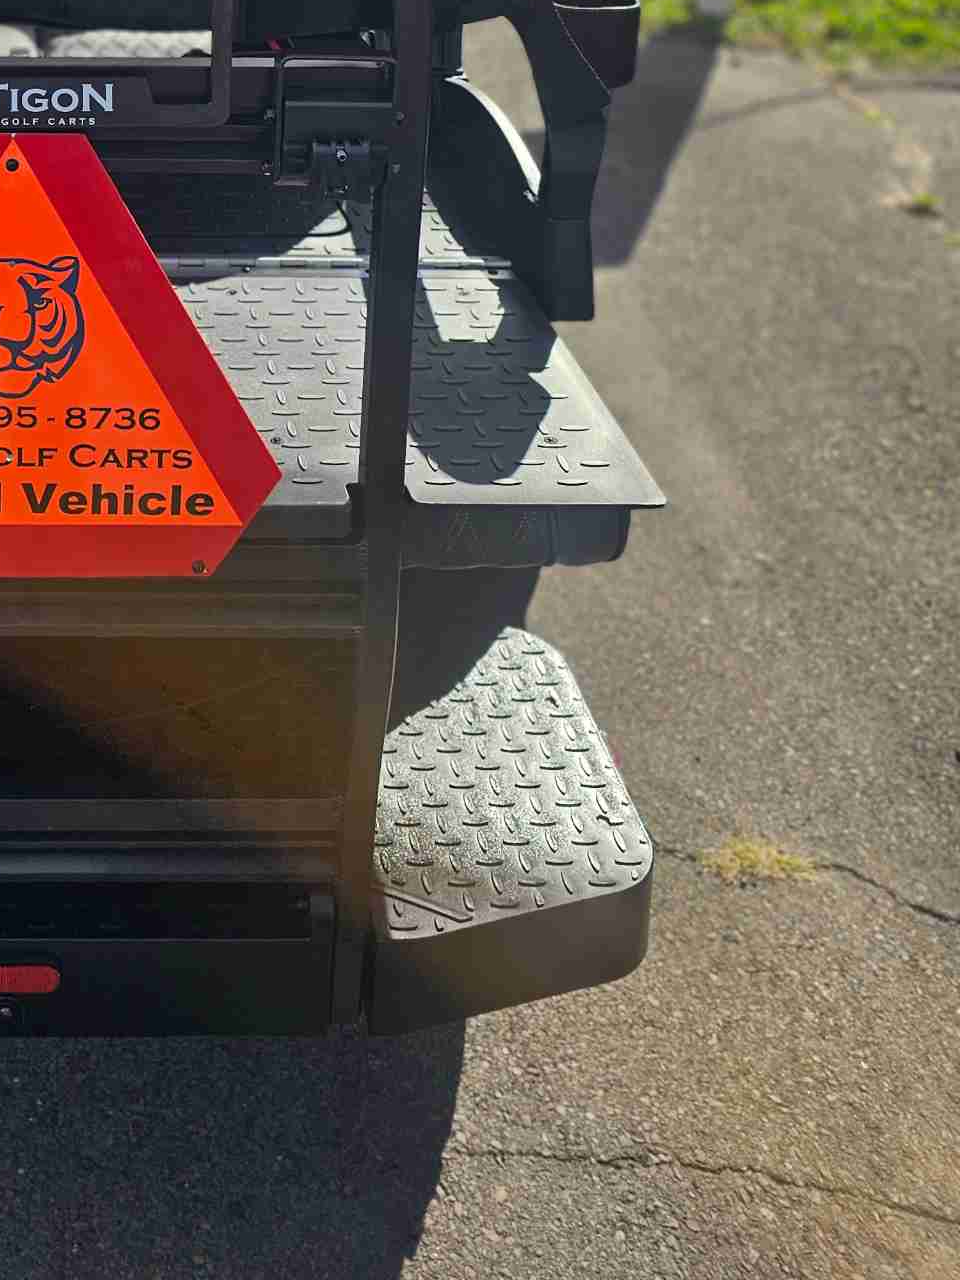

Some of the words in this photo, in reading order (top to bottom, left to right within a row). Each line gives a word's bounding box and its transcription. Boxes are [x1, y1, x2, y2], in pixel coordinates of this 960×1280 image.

[0, 117, 39, 127] GOLF
[47, 117, 96, 127] CARTS
[69, 444, 193, 469] CARTS
[22, 483, 215, 516] Vehicle
